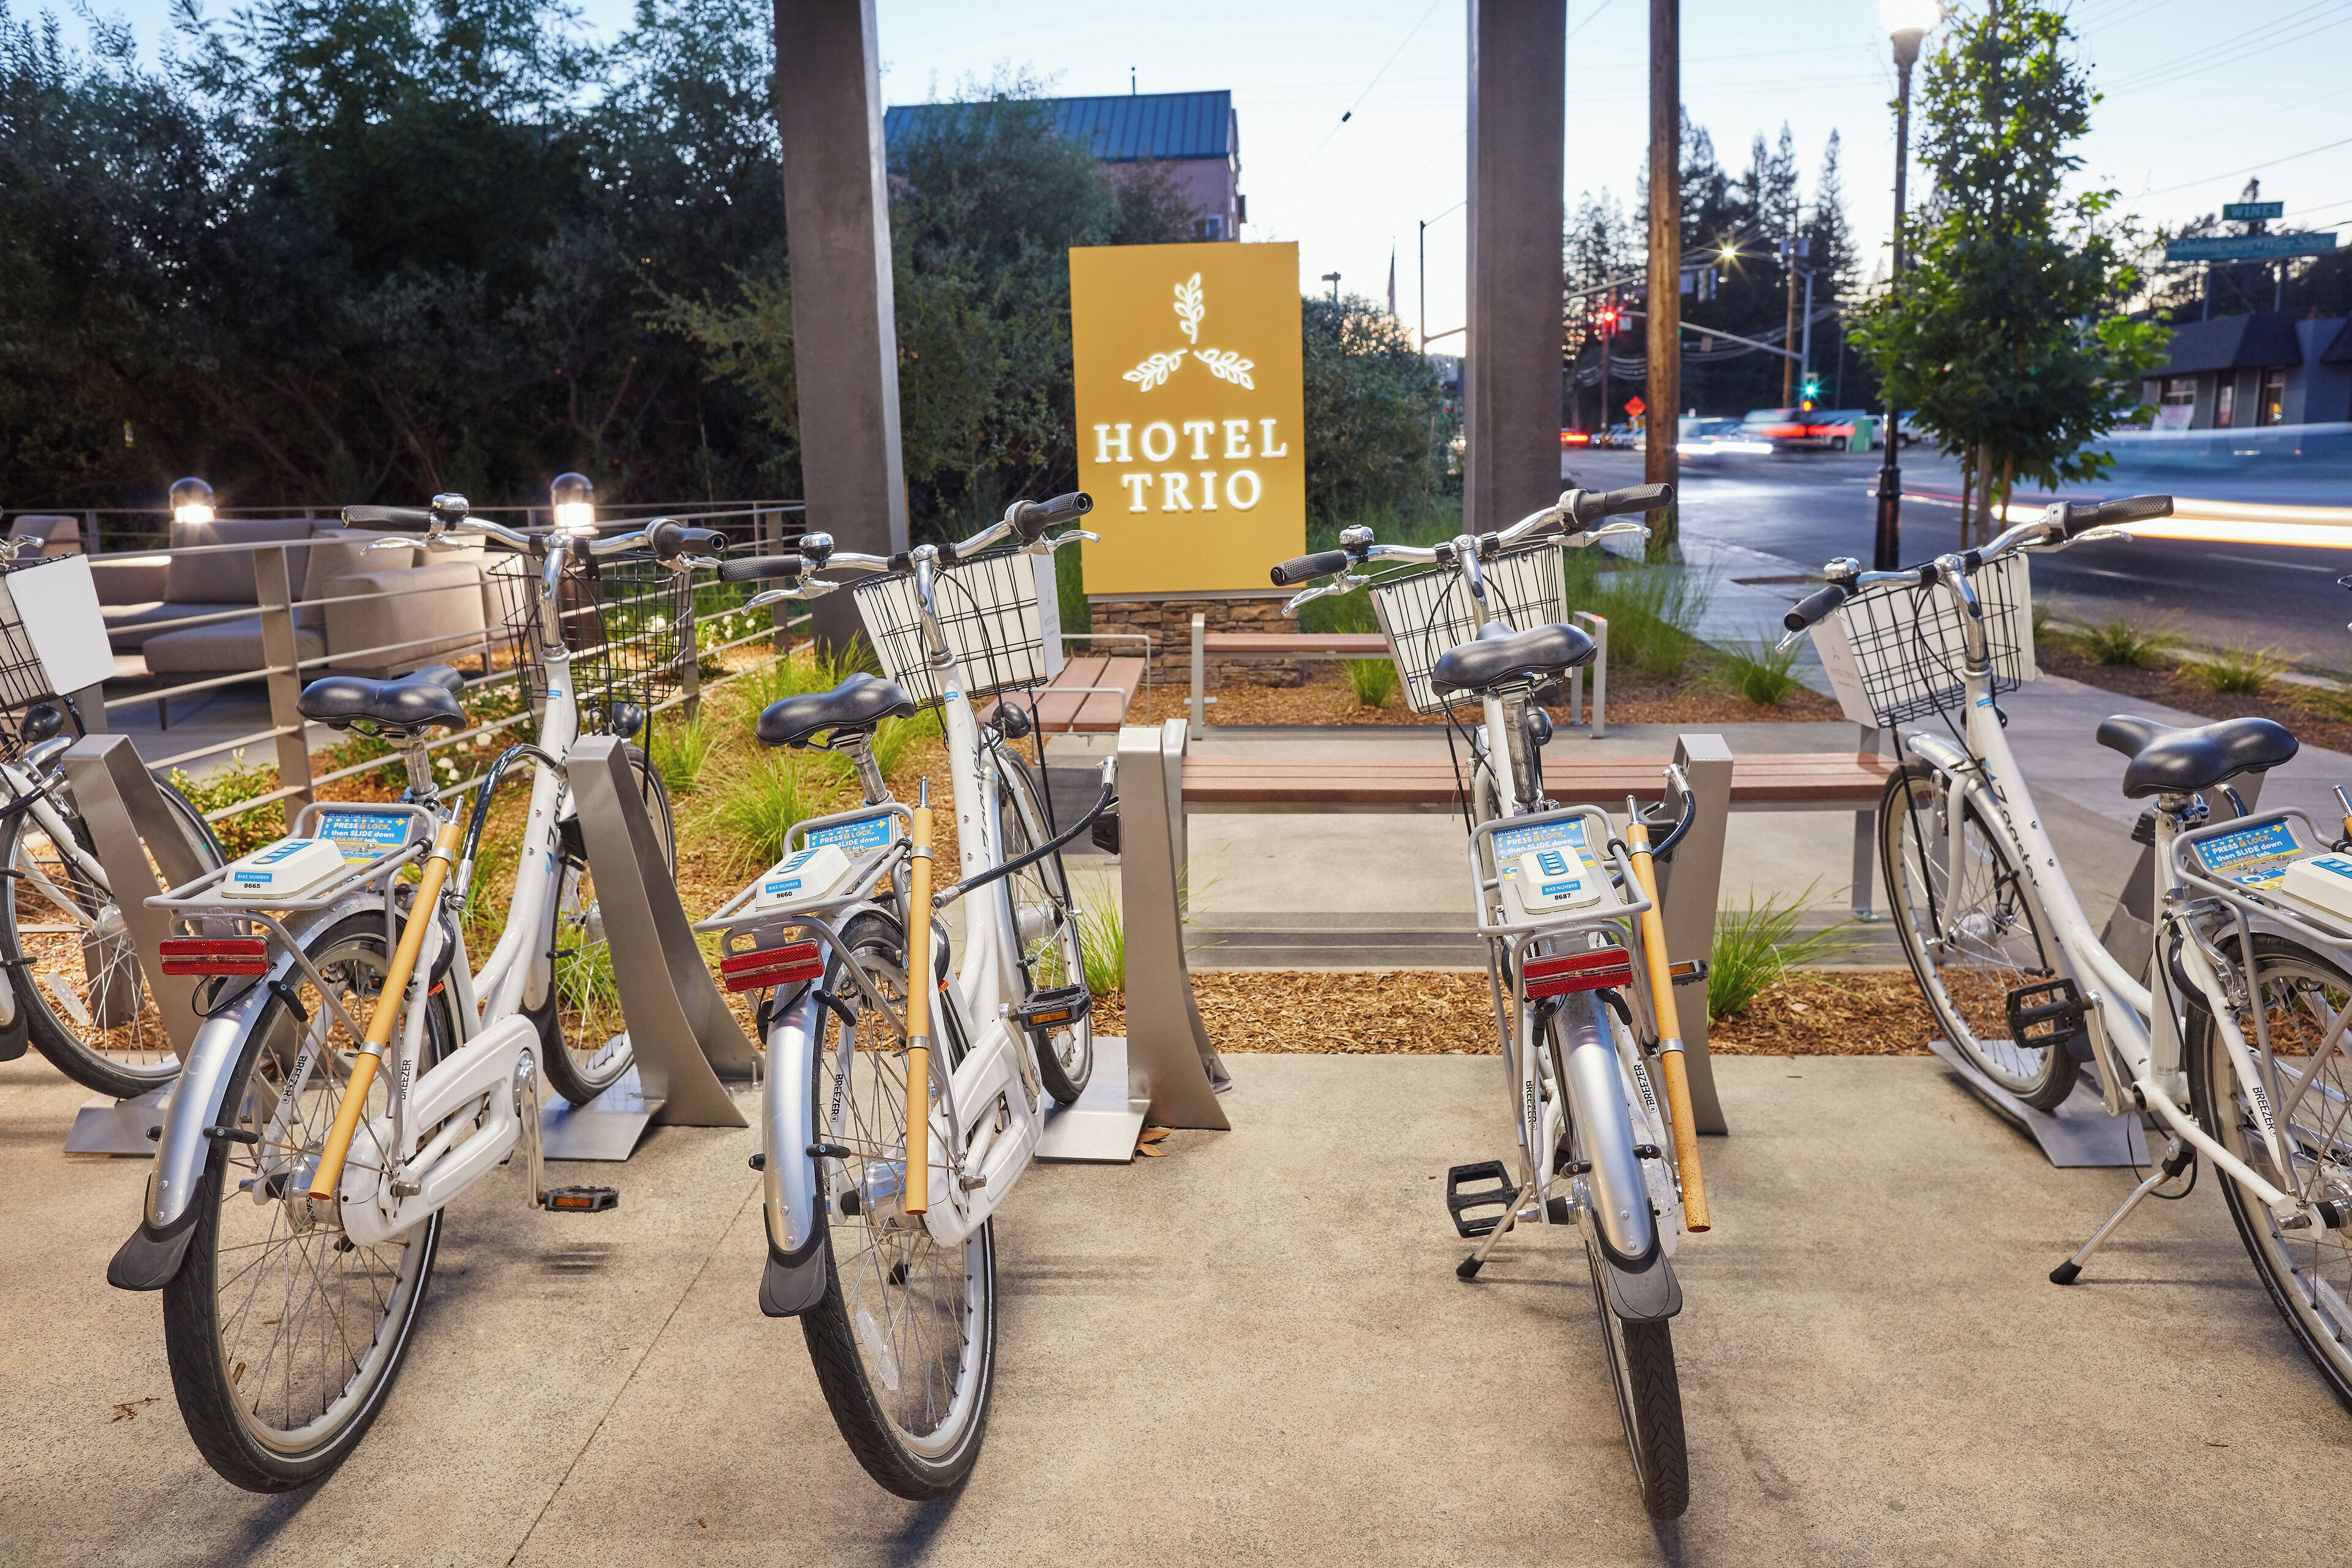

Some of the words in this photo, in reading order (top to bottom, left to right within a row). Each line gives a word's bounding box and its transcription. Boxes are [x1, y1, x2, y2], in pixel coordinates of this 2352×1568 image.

[1093, 418, 1287, 464] HOTEL
[1121, 470, 1261, 512] TRIO
[820, 834, 843, 844] PRESS
[851, 829, 874, 839] LOCK,
[837, 839, 858, 848] SLIDE
[1507, 836, 1532, 846] PRESS
[1508, 845, 1526, 853] then
[1528, 841, 1551, 850] SLIDE
[2212, 843, 2239, 854] PRESS
[2247, 834, 2273, 845] LOCK,
[2216, 853, 2235, 862] then
[2236, 845, 2260, 857] SLIDE
[2261, 840, 2283, 850] down
[2221, 854, 2256, 867] ORANGE
[831, 1074, 843, 1115] BREEZER
[1634, 1064, 1655, 1107] BREEZER
[2252, 1086, 2275, 1131] BREEZER
[247, 1434, 267, 1460] CITYWIDE
